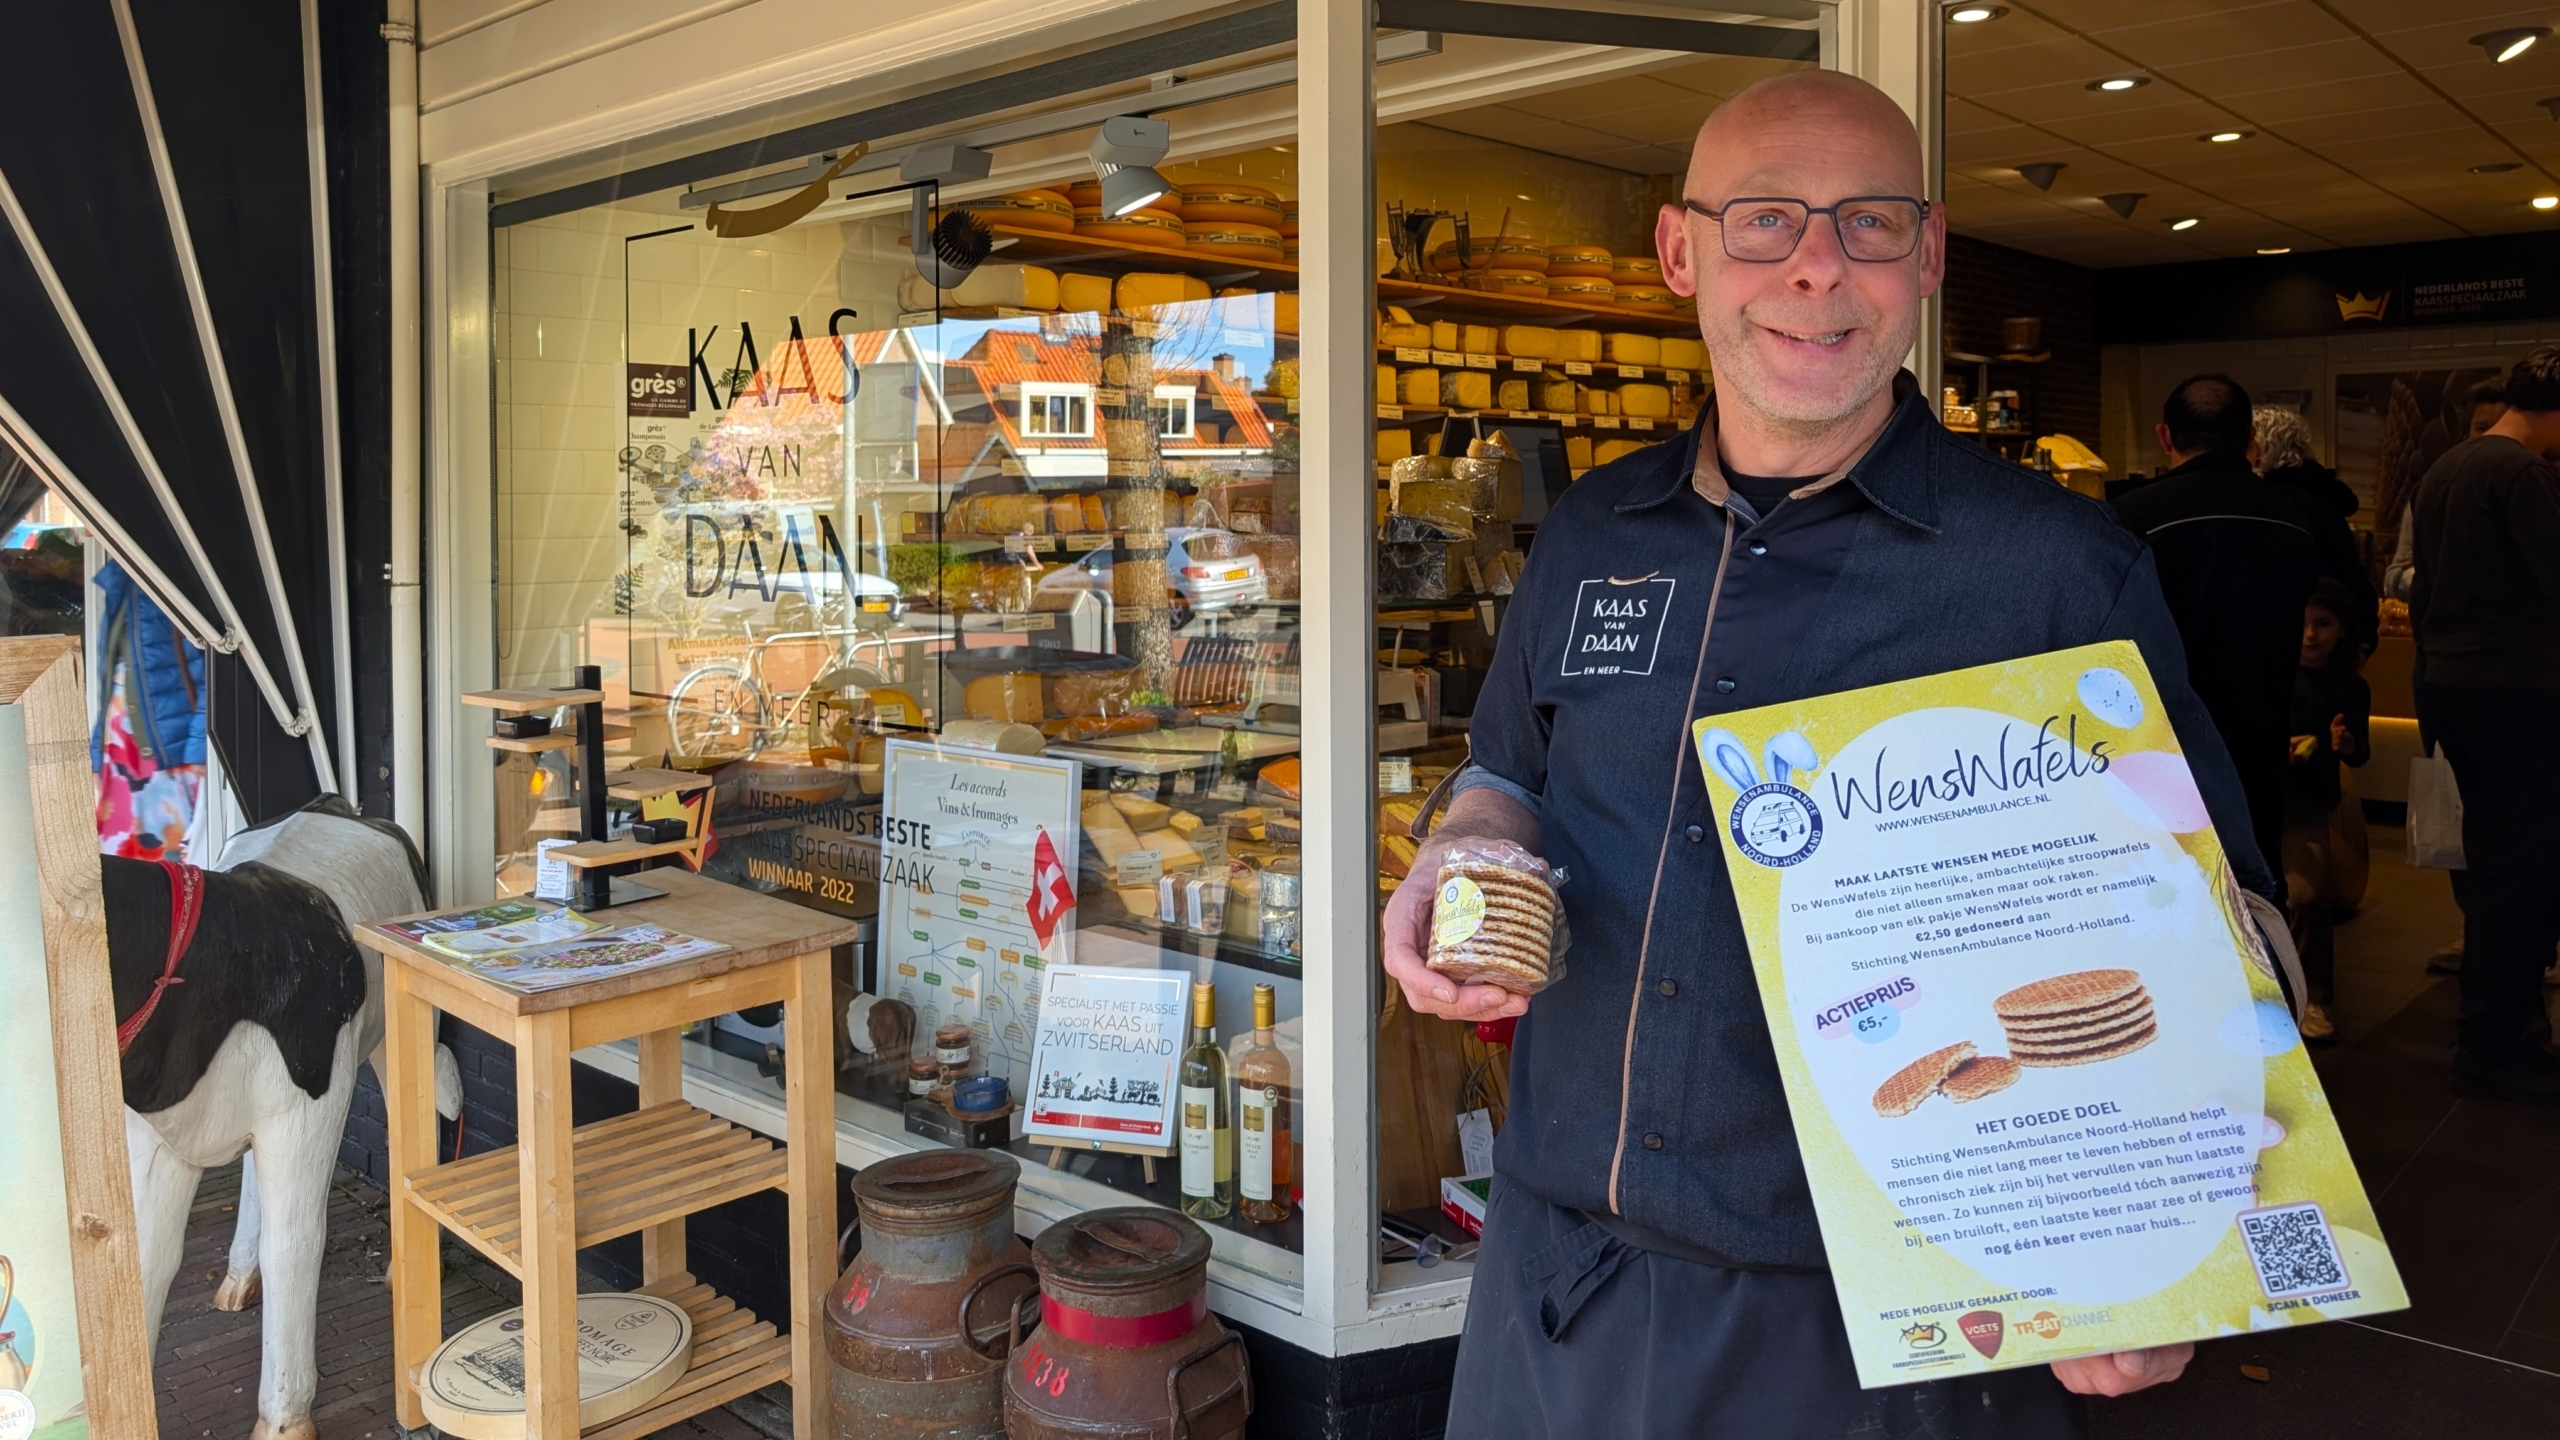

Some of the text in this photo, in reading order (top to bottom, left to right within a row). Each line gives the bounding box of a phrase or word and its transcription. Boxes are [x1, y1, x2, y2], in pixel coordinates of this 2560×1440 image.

[2414, 278, 2525, 295] NEDERLANDS BESTE
[2414, 289, 2527, 307] KAASSPECIAALZAAK
[688, 308, 861, 412] KAAS
[736, 443, 801, 478] VAN
[685, 514, 864, 608] DAAN
[1592, 598, 1649, 618] KAAS
[1603, 621, 1626, 630] VAN
[1581, 634, 1640, 653] DAAN
[1583, 666, 1621, 676] EN MEER
[714, 689, 831, 728] EN MEER
[949, 773, 1008, 799] Les accords
[1831, 713, 2117, 820] WensWafels
[749, 787, 932, 851] NEDERLANDS BESTE
[937, 796, 1019, 830] Vins & fromages
[1731, 784, 1819, 830] WENSENAMBULANCE
[1874, 793, 2053, 833] WWW.WENSENAMBULANCE.NL
[749, 823, 936, 895] KAASSPECIAALZAAK
[1740, 829, 1821, 867] NOORD-HOLLAND
[1834, 833, 2099, 889] MAAK LAATSTE WENSEN MEDE MOGELIJK
[748, 856, 855, 905] WINNAAR 2022
[1791, 841, 2151, 913] De WensWafels zijn heerlijke, ambachtelijke stroopwafels
[1854, 866, 2100, 919] die niet alleen smaken maar ook raken.
[1805, 873, 2159, 945] Bij aankoop van elk pakje WensWafels wordt er namelijk
[1915, 911, 2052, 943] €2,50 gedoneerd aan
[1851, 912, 2136, 972] Stichting WensenAmbulance Noord-Holland.
[1047, 995, 1179, 1016] SPECIALIST MET PASSIE
[1816, 976, 1916, 1031] ACTIEPRIJS
[1056, 1012, 1164, 1035] VOOR KAAS UIT
[1857, 1015, 1889, 1033] €5,-
[1041, 1030, 1175, 1057] ZWITSERLAND
[1890, 1105, 2228, 1170] Stichting WensenAmbulance Noord-Holland helpt
[1975, 1101, 2122, 1135] HET GOEDE DOEL
[1887, 1122, 2247, 1190] mensen die niet lang meer te leven hebben of ernstig
[1898, 1143, 2246, 1208] chronisch ziek zijn bij het vervullen van hun laatste
[1893, 1160, 2263, 1229] wensen. Zo kunnen zij bijvoorbeeld tóch aanwezig zijn
[1904, 1181, 2262, 1249] bij een bruiloft, een laatste keer naar zee of gewoon
[1984, 1214, 2197, 1256] nog één keer even naar huis...
[1879, 1287, 2059, 1322] MEDE MOGELIJK GEMAAKT DOOR:
[2266, 1290, 2362, 1312] SCAN & DONEER
[1964, 1321, 2000, 1336] VOETS
